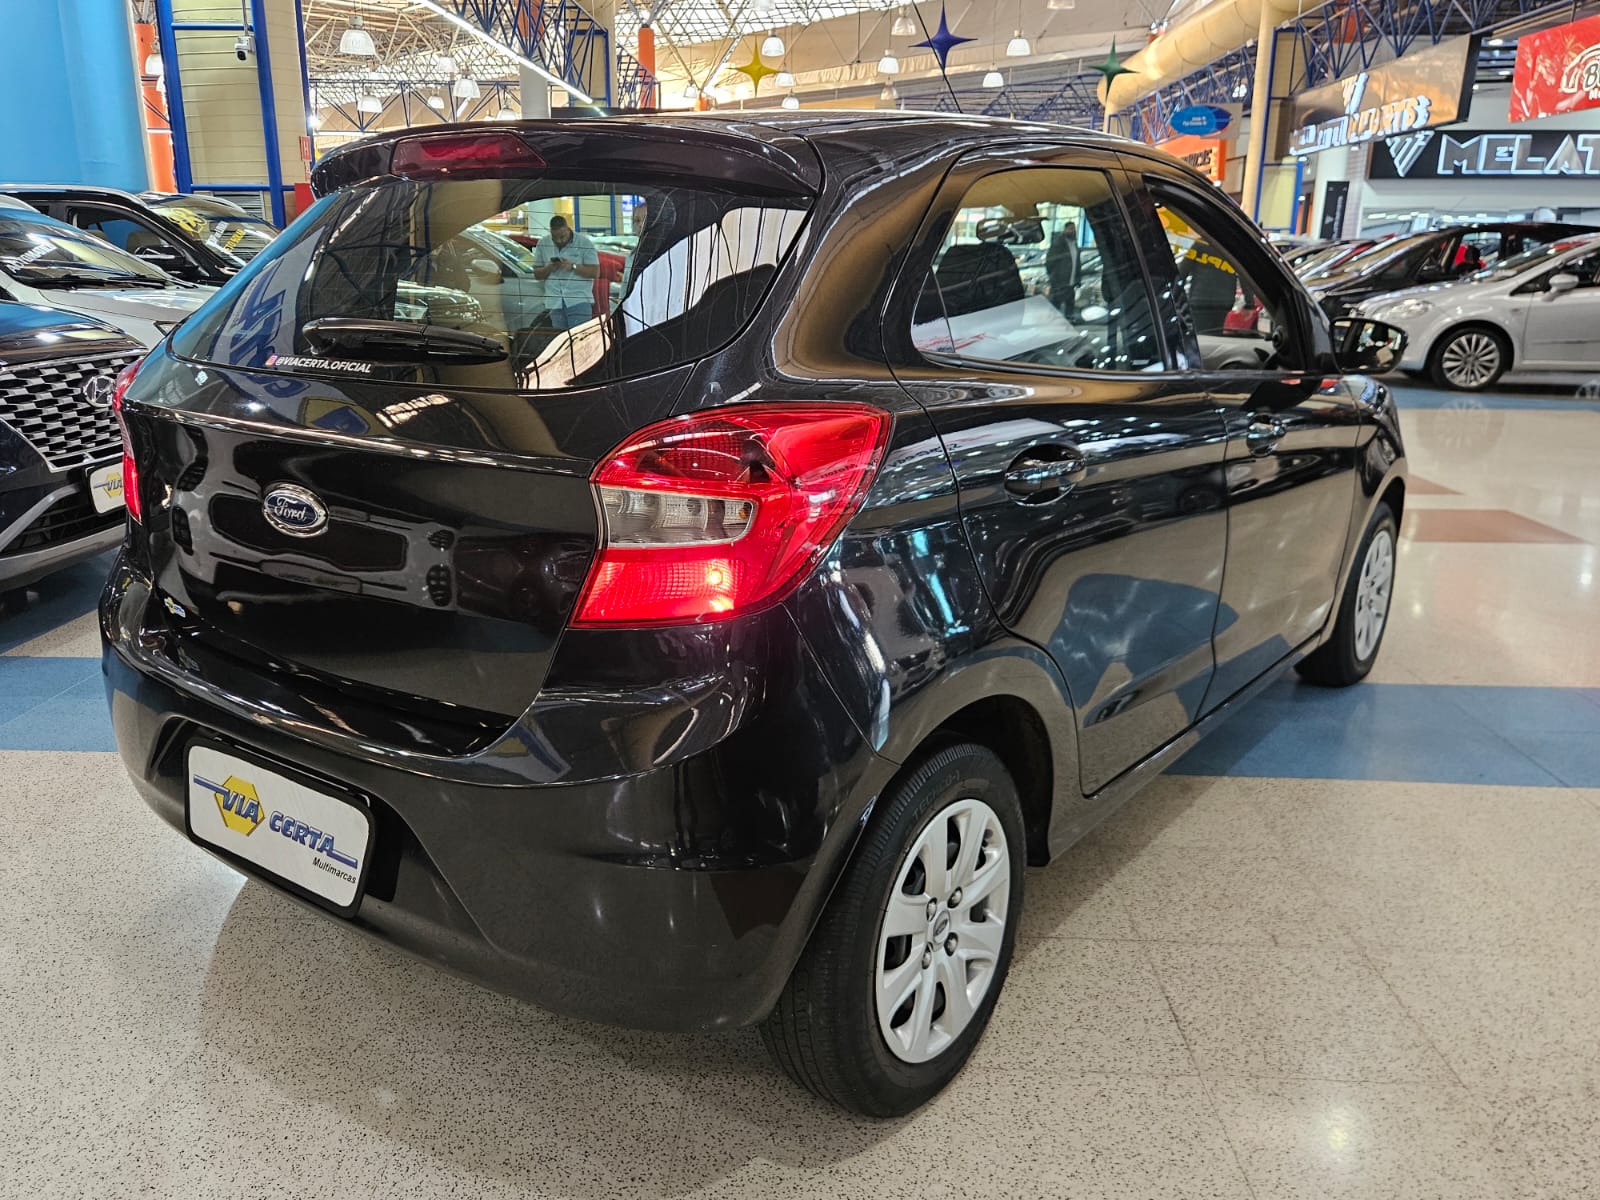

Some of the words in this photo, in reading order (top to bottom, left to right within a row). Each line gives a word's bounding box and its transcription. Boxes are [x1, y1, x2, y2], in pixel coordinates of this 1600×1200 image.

[275, 356, 371, 373] @VIACERTA.OFICIAL
[274, 497, 307, 521] Ford
[221, 789, 260, 825] VIA
[269, 810, 335, 857] CERTA
[312, 856, 357, 884] Multimarcas
